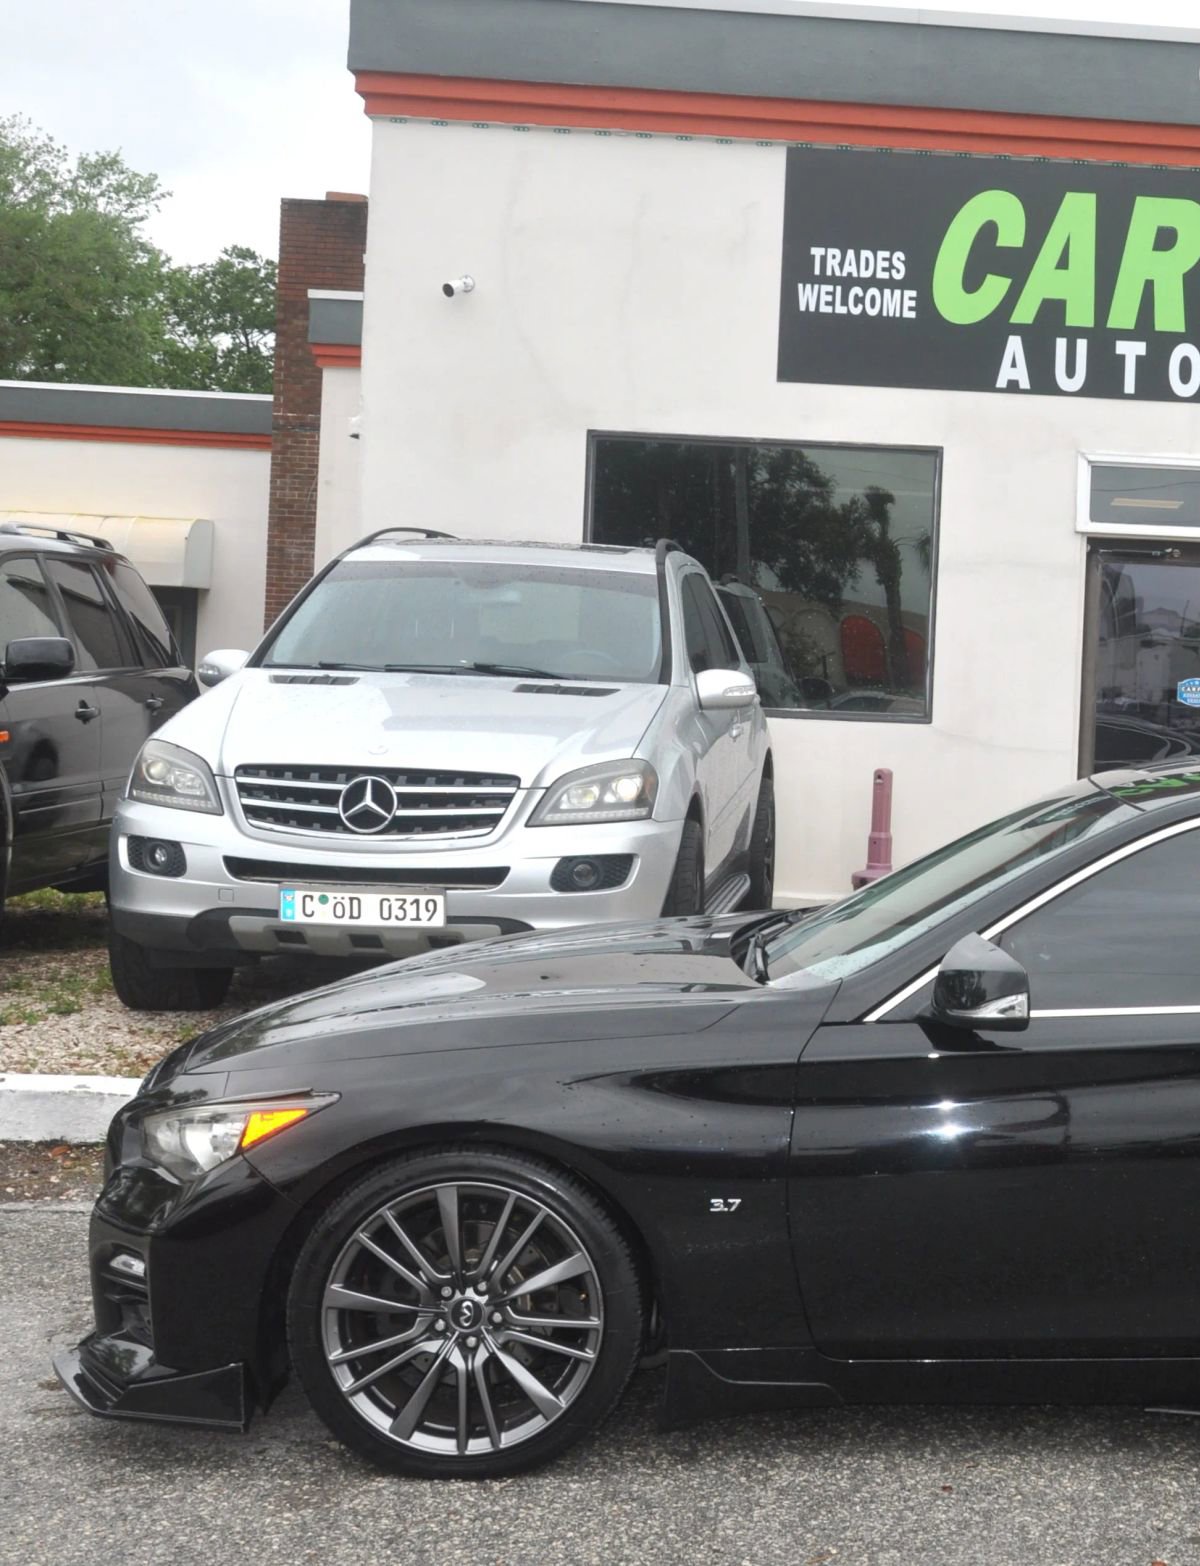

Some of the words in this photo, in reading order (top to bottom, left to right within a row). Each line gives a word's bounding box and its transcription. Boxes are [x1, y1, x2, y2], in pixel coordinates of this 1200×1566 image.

[809, 246, 906, 281] TRADES
[797, 283, 918, 319] WELCOME
[302, 894, 315, 918] C
[379, 898, 438, 922] 0319
[710, 1198, 741, 1211] 3.7
